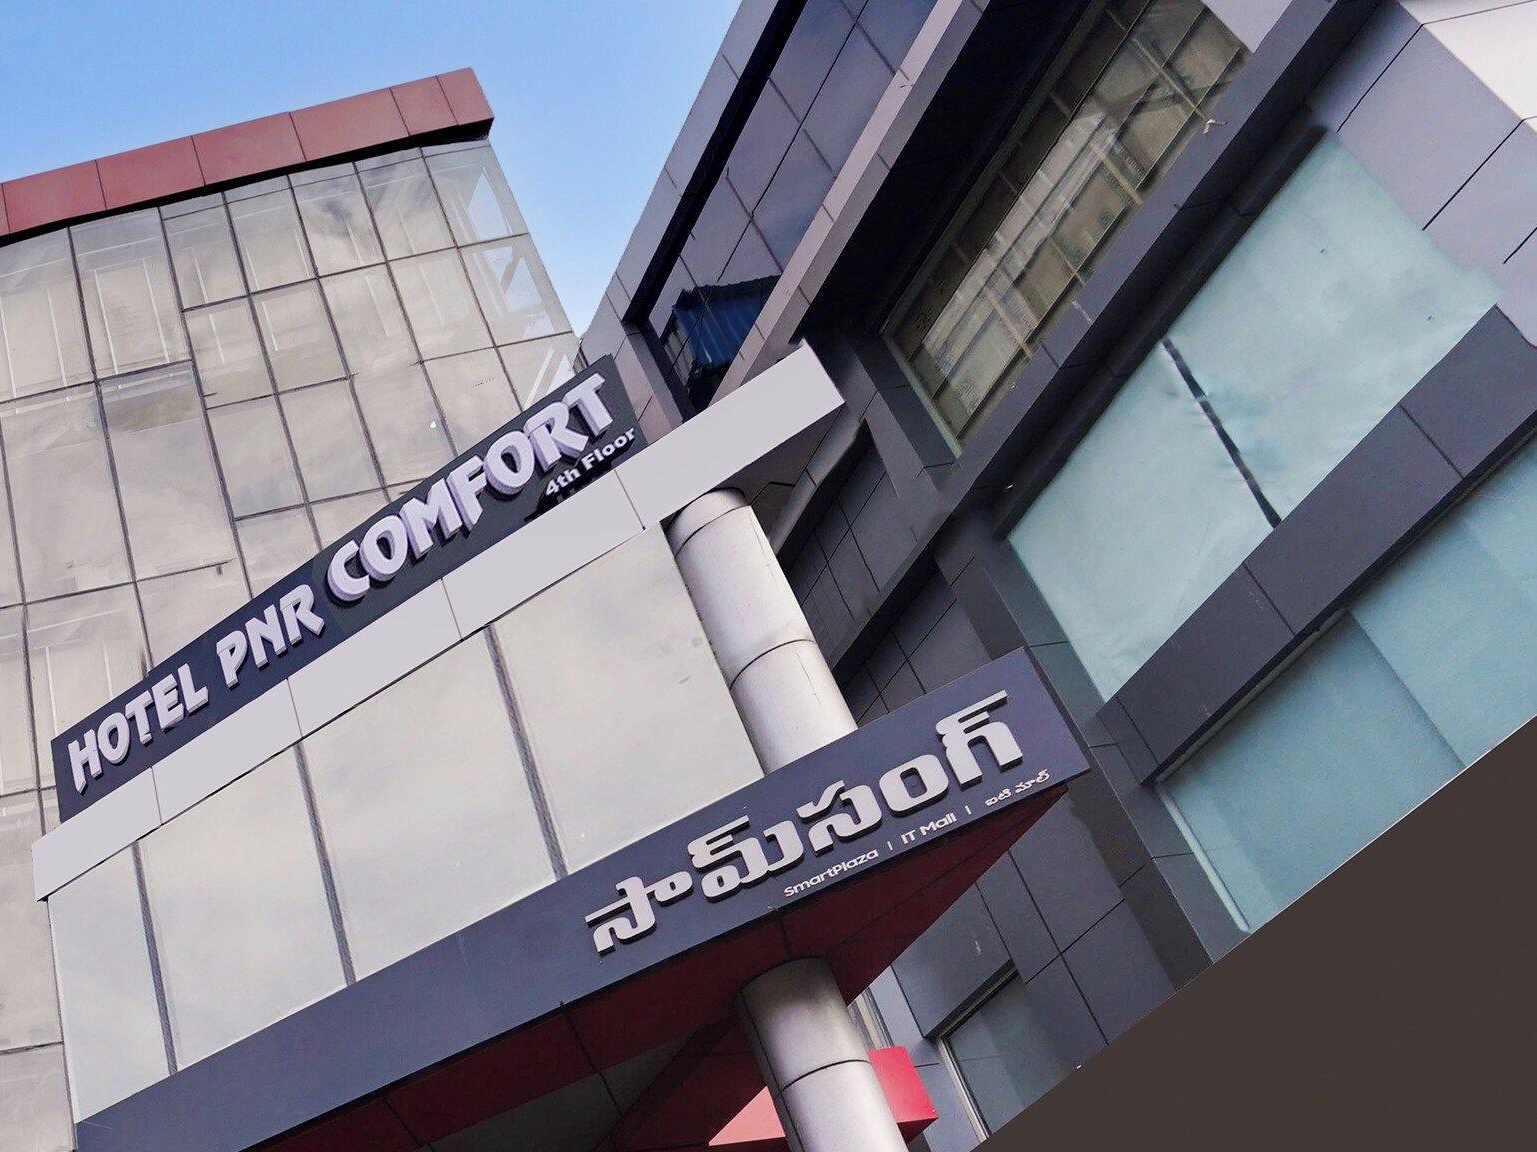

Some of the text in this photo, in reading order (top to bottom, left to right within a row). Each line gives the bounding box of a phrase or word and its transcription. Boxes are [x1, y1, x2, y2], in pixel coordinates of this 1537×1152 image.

[545, 427, 635, 496] 4th Floor
[68, 373, 613, 794] HOTEL PNR COMFORT
[783, 813, 958, 898] SmartPlaza IT Mall
